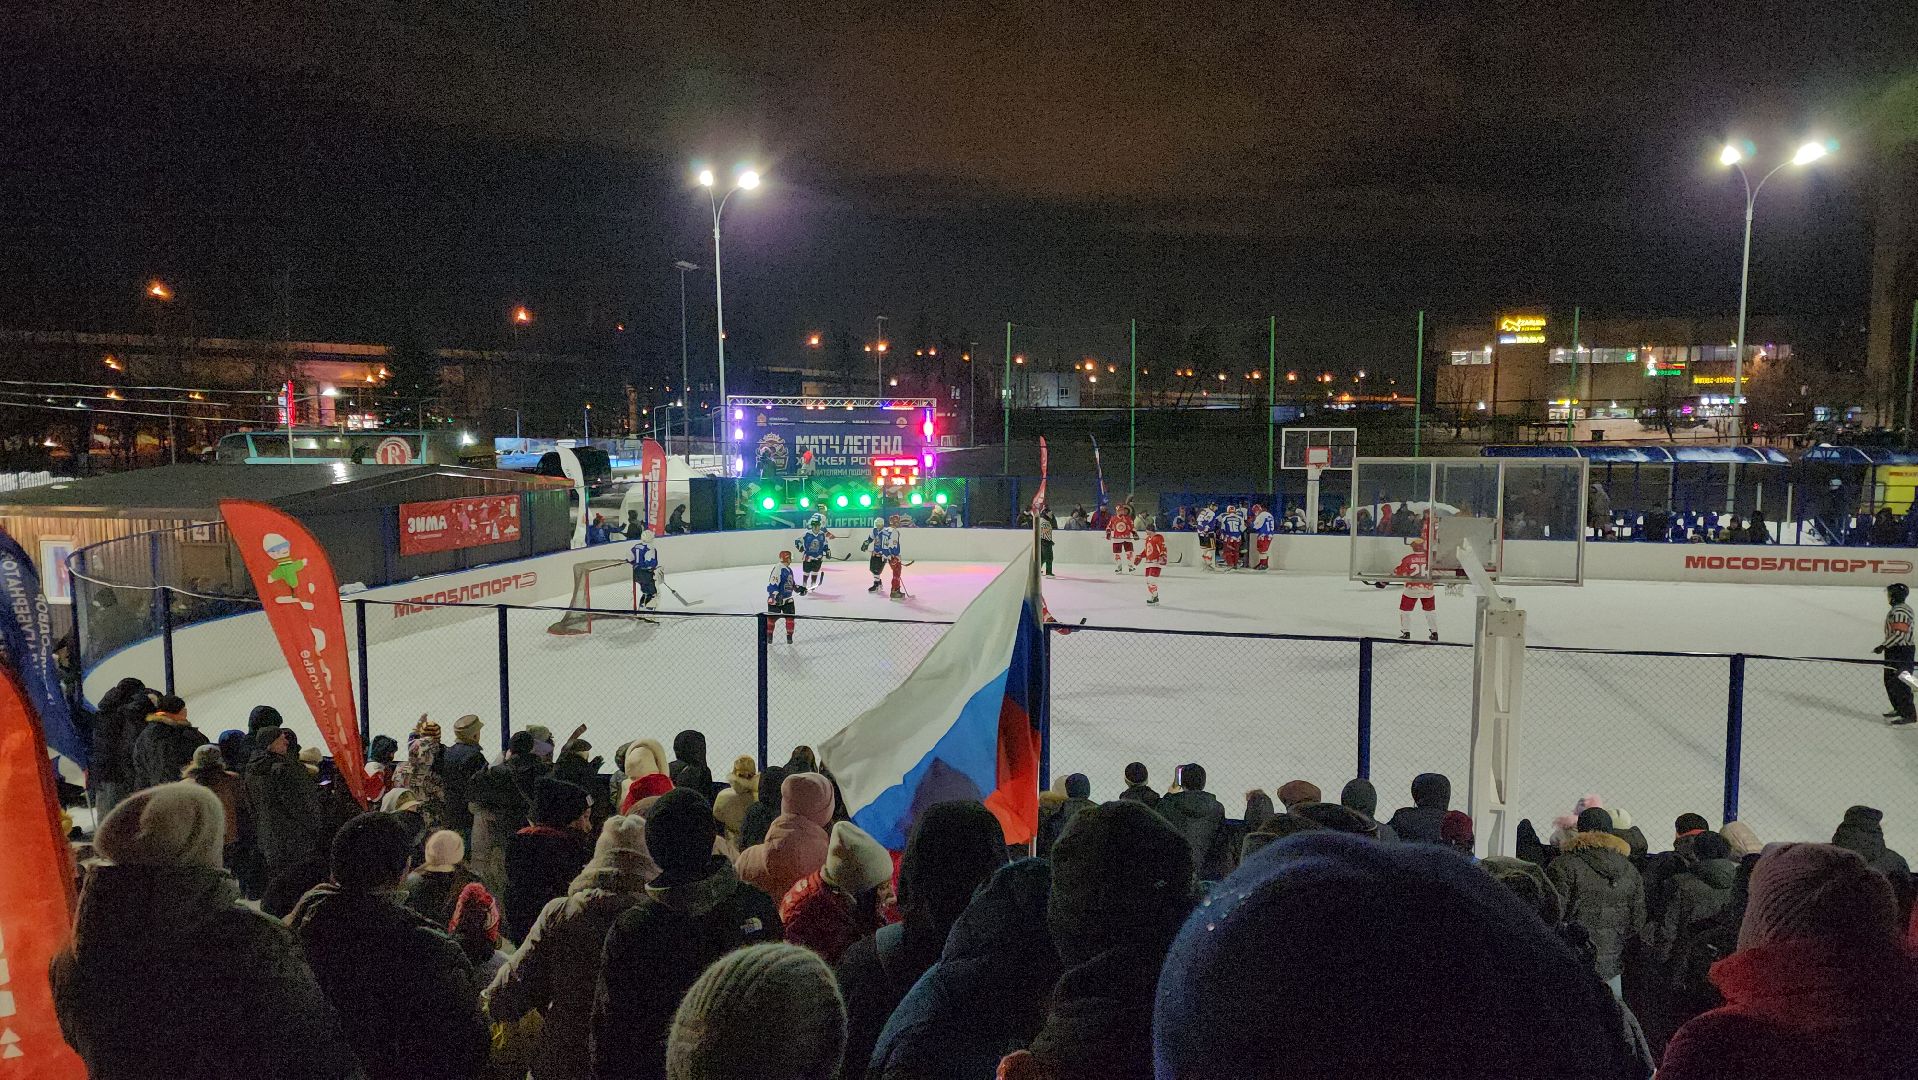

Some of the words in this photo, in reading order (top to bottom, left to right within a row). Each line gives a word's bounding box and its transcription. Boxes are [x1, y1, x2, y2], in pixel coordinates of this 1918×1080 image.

[796, 435, 840, 454] МАТЧ
[842, 435, 903, 455] ЛЕГЕНД
[796, 457, 847, 466] ХККЕЯ
[407, 514, 448, 534] ЗИМА
[1685, 556, 1885, 573] МОСОБЛСПОРТ
[393, 575, 522, 618] МОСОБЛСПОРТ
